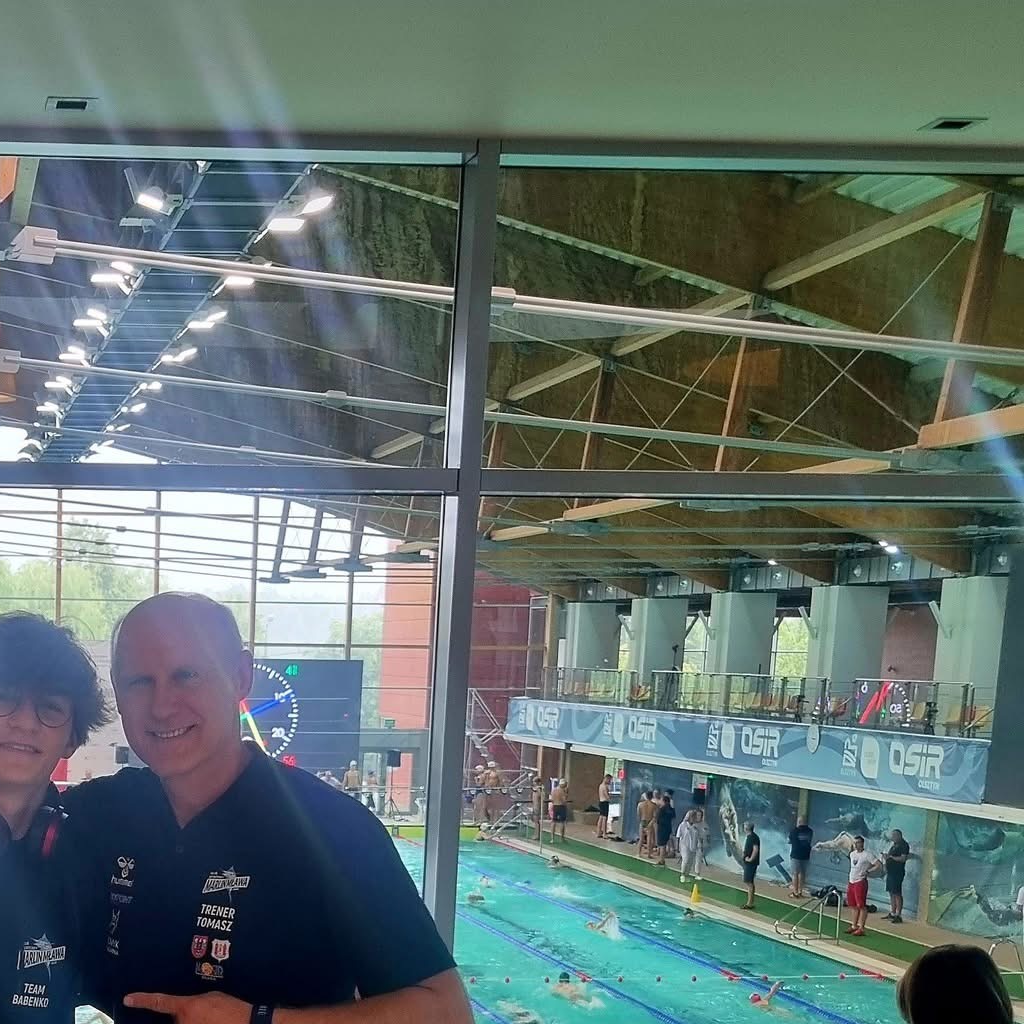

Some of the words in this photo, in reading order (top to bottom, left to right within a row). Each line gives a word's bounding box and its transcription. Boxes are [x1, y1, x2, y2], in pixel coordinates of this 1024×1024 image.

[272, 727, 285, 738] 20
[200, 903, 236, 919] TRENER
[196, 916, 233, 932] TOMASZ
[23, 983, 46, 995] TEAM
[12, 994, 49, 1008] BABENKO
